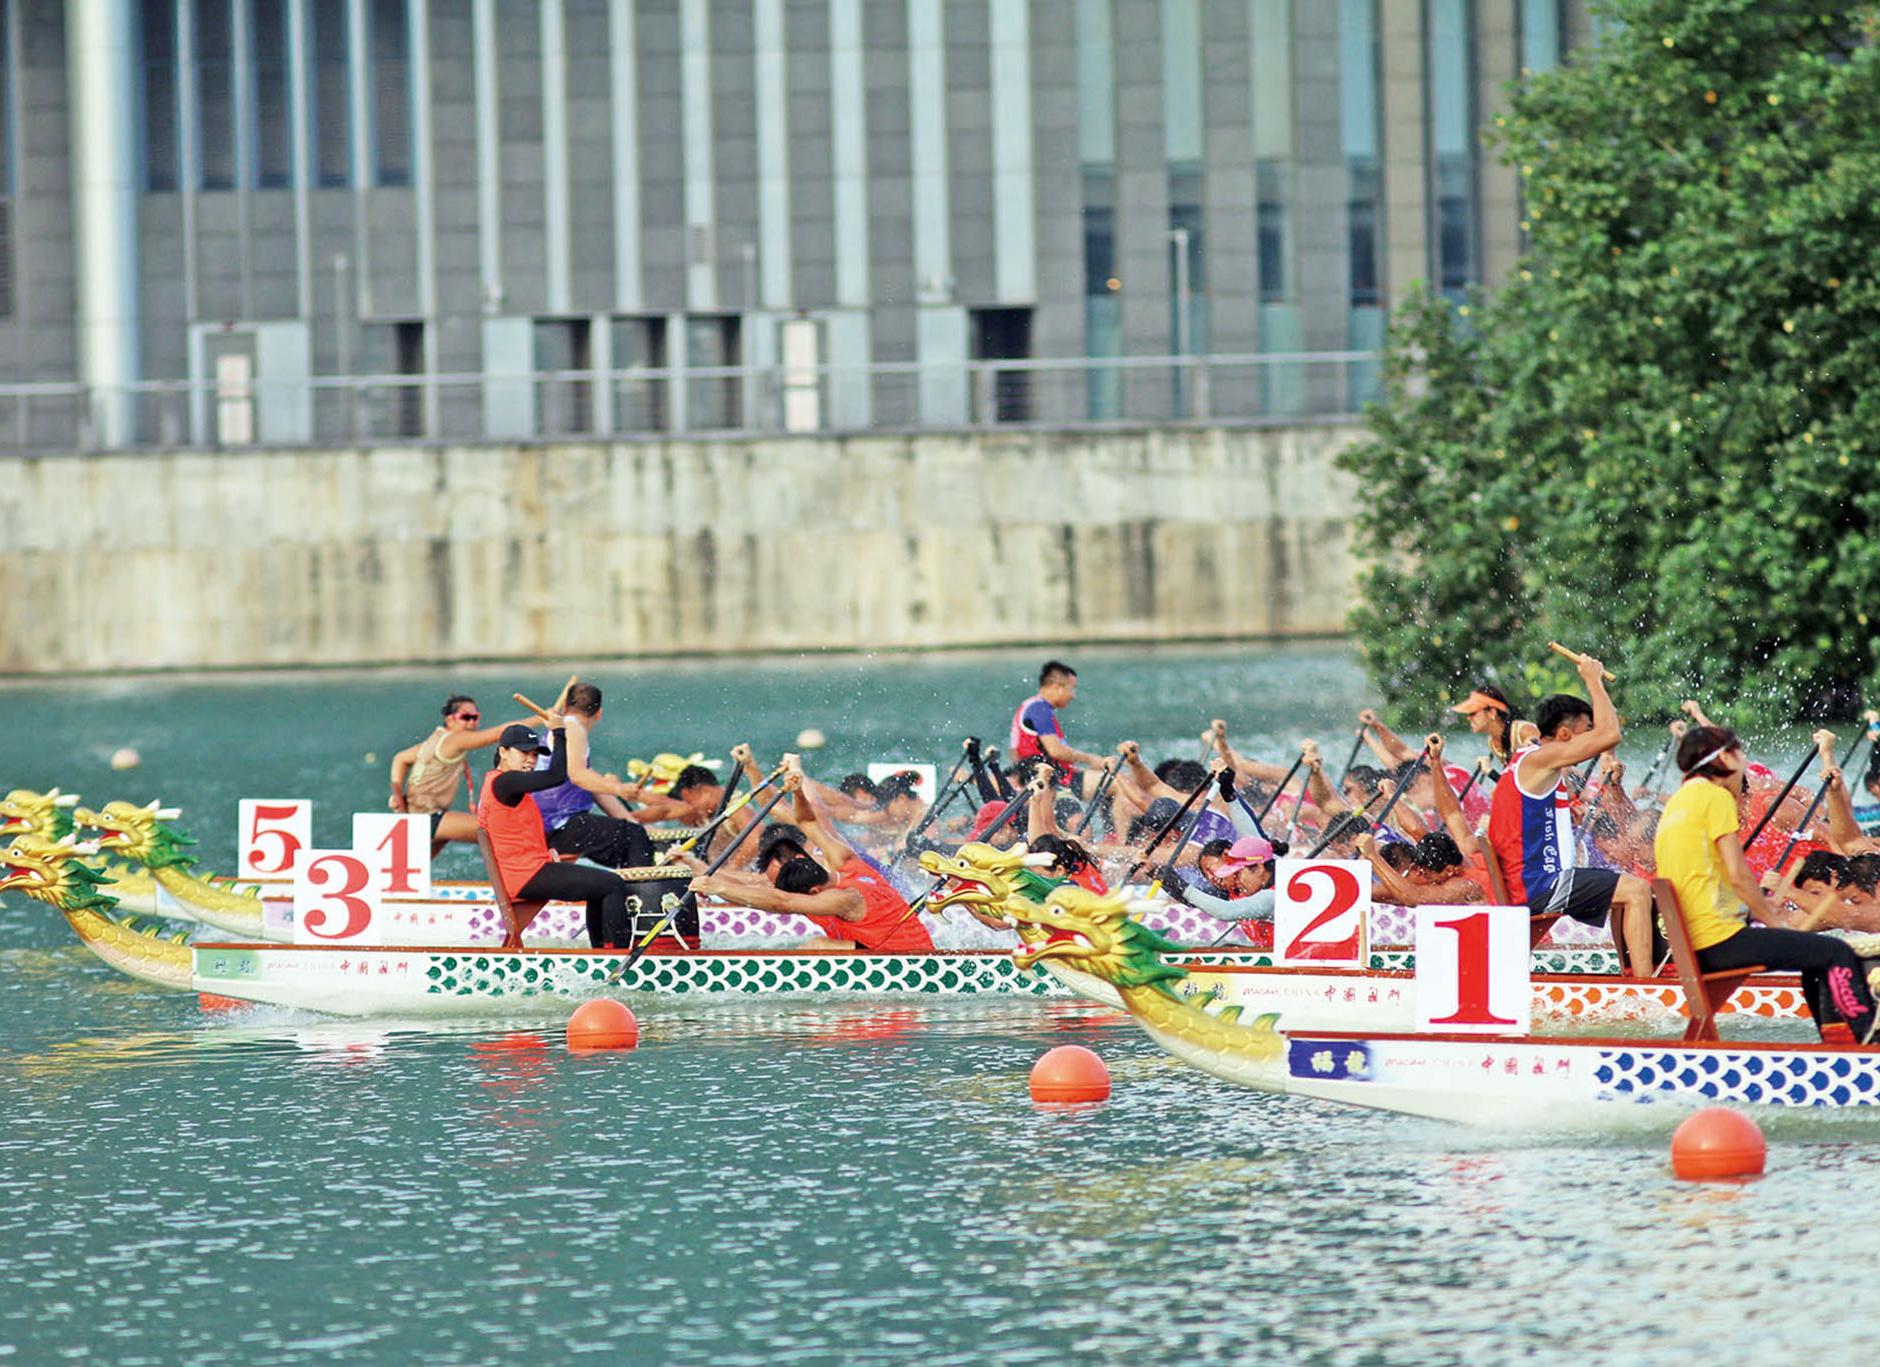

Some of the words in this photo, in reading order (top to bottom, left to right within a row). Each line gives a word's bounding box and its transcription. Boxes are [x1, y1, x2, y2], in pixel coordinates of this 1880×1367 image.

[248, 805, 301, 873] 5
[377, 818, 421, 893] 4
[304, 855, 372, 939] 3
[1285, 865, 1360, 961] 2
[1428, 912, 1517, 1025] 1
